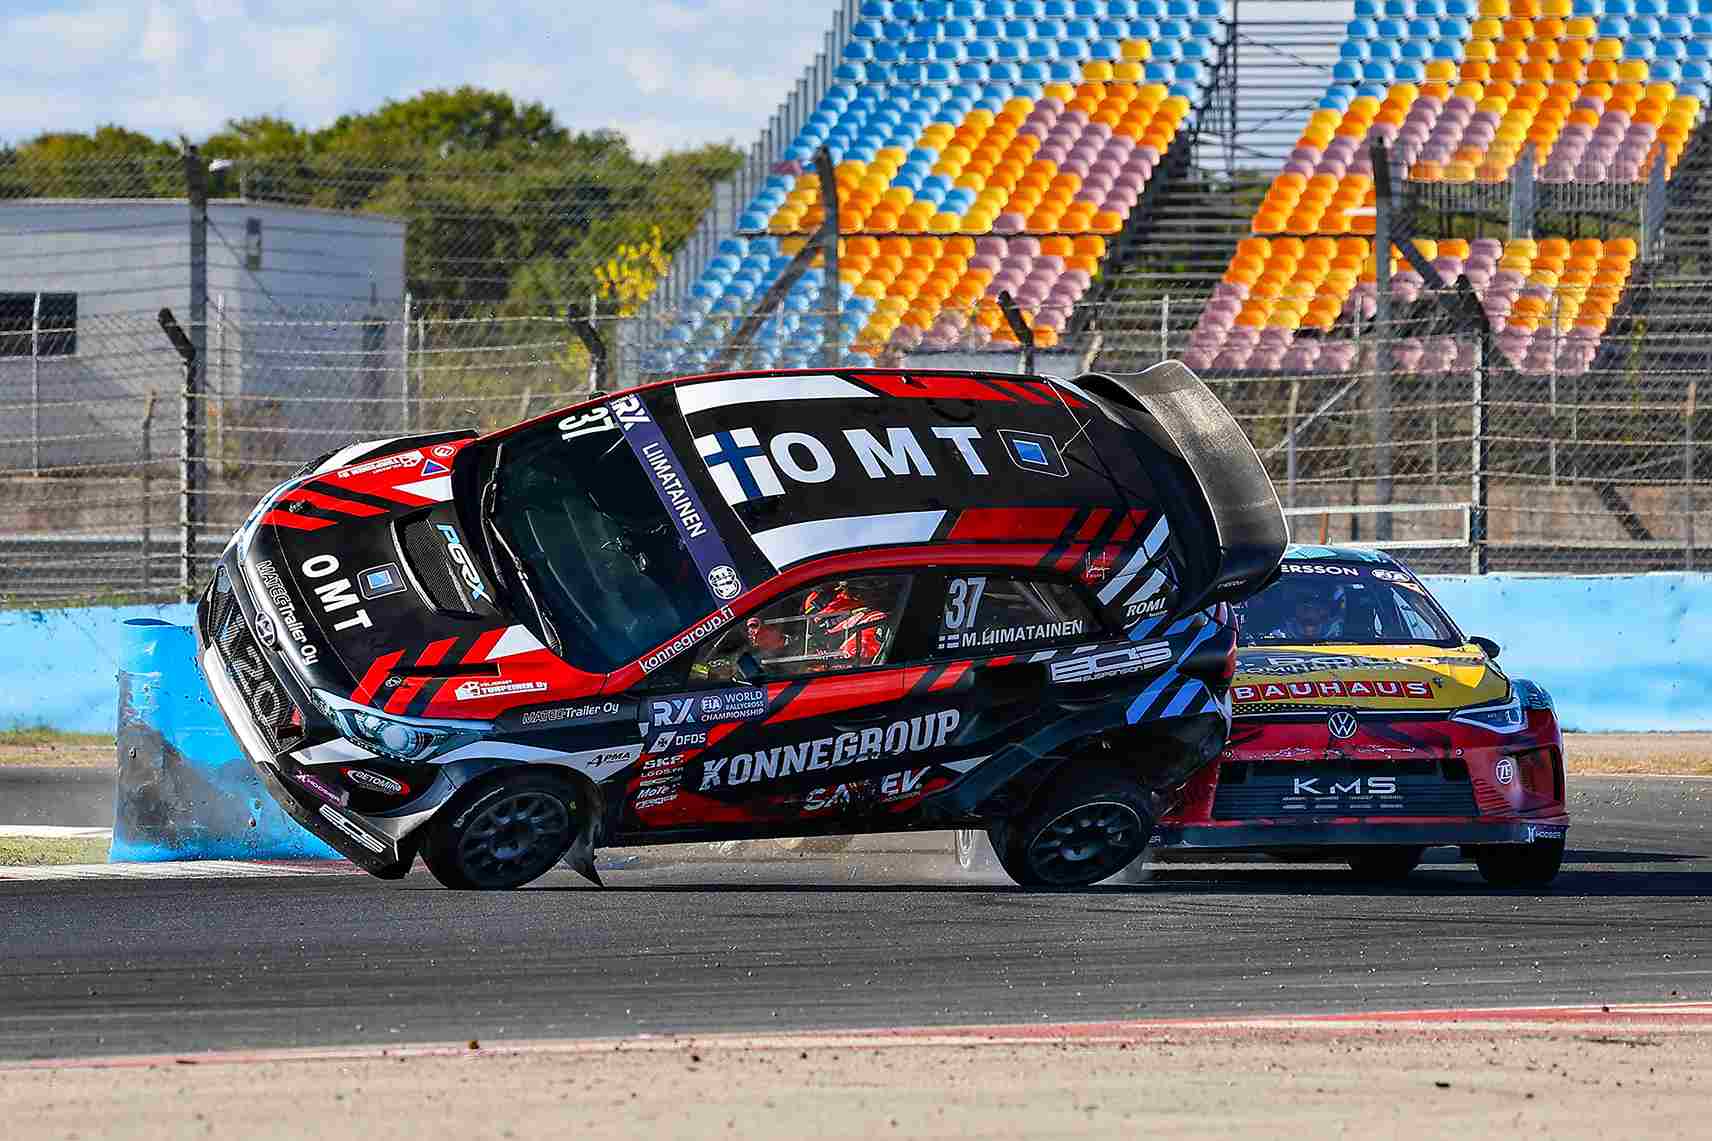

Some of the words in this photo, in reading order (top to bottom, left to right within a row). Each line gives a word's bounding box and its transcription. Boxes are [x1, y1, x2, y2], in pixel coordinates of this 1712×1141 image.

[558, 407, 620, 441] 37
[769, 426, 989, 484] OMT
[642, 441, 707, 538] LIIMATAINEN
[301, 553, 374, 632] OMT
[944, 576, 987, 630] 37
[1126, 597, 1167, 617] ROMI
[638, 604, 736, 674] konnegroup.fi
[300, 643, 320, 667] Oy
[724, 690, 763, 703] WORLD
[1233, 679, 1429, 700] BAUHAUS
[603, 702, 620, 714] Oy
[652, 698, 697, 727] RX
[701, 708, 765, 722] CHAMPIONSHIP
[725, 702, 764, 710] RALLYCROSS
[675, 732, 707, 746] DFDS
[699, 708, 960, 792] KONNEGROUP
